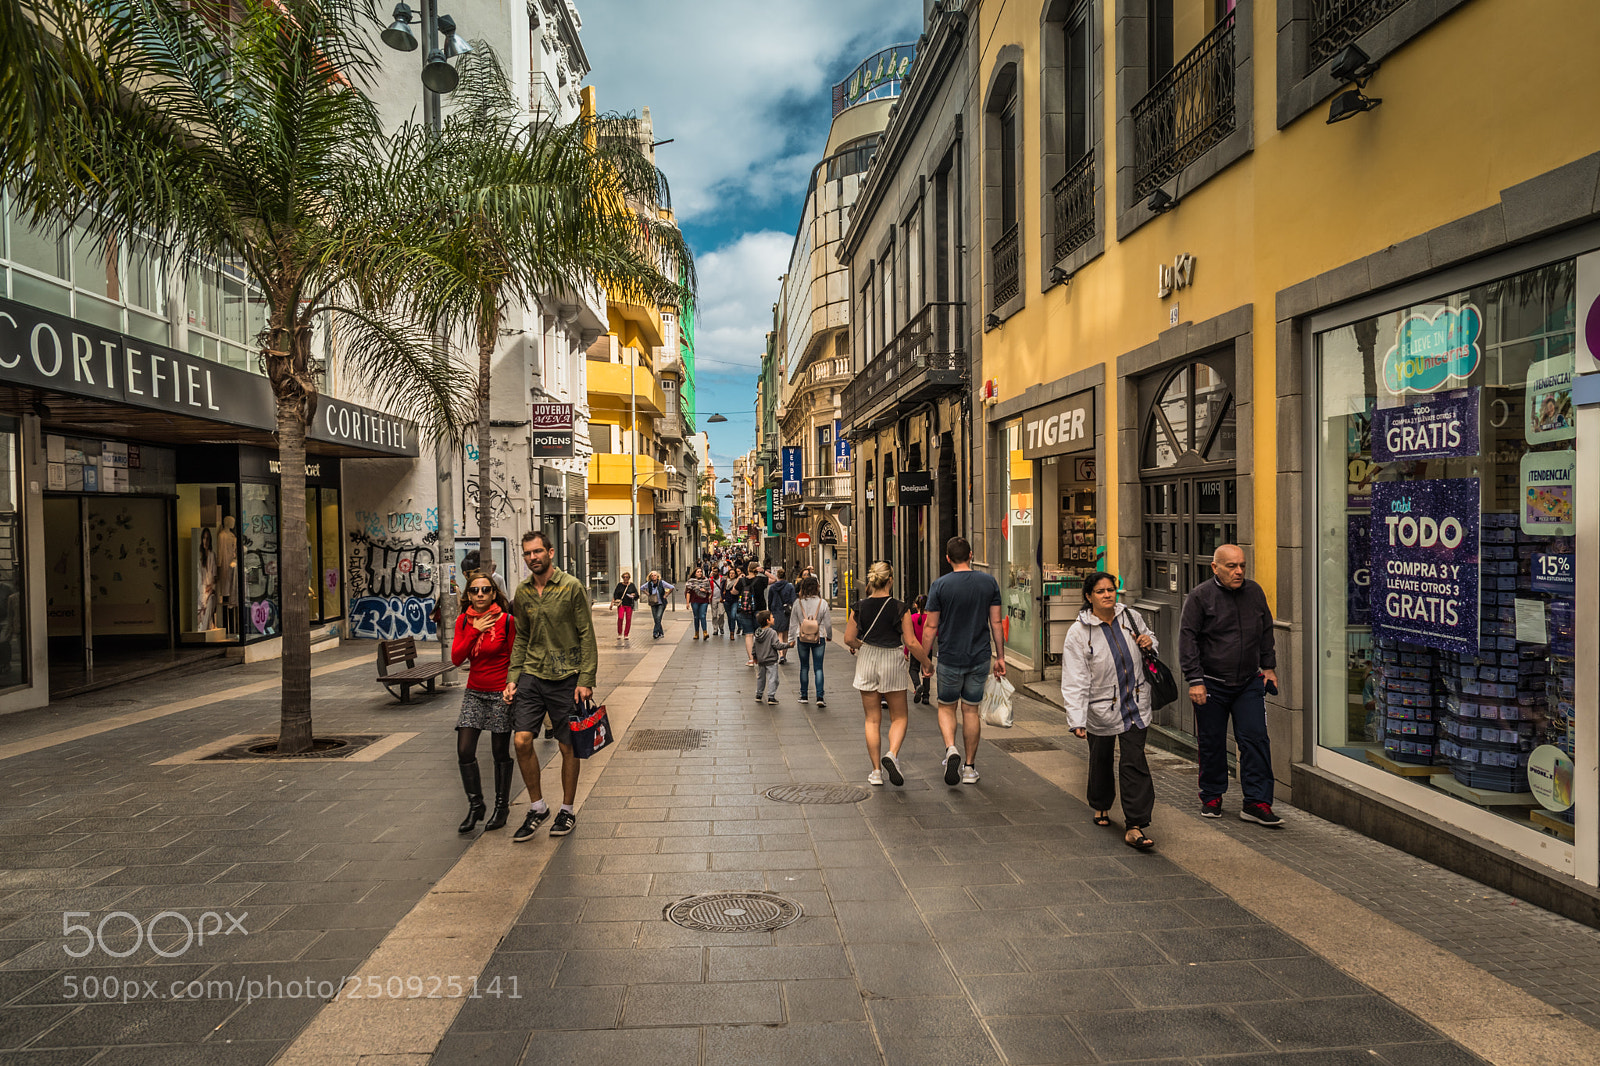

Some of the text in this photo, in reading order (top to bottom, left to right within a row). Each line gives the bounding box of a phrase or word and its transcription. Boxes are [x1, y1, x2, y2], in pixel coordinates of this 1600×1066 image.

[1434, 329, 1445, 347] IN
[0, 311, 220, 411] CORTEFIEL
[534, 405, 571, 415] JOYERIA
[326, 404, 407, 450] CORTEFIEL
[1027, 408, 1086, 450] TIGER
[1386, 420, 1461, 453] GRATIS
[1385, 515, 1463, 550] TODO
[1386, 560, 1437, 579] COMPRA
[1439, 564, 1448, 579] 3
[1450, 565, 1460, 580] Y
[1538, 555, 1570, 576] 15%
[1386, 576, 1460, 596] LLÉVATE OTROS 3
[1008, 605, 1026, 621] TIGER
[1386, 592, 1459, 627] GRATIS
